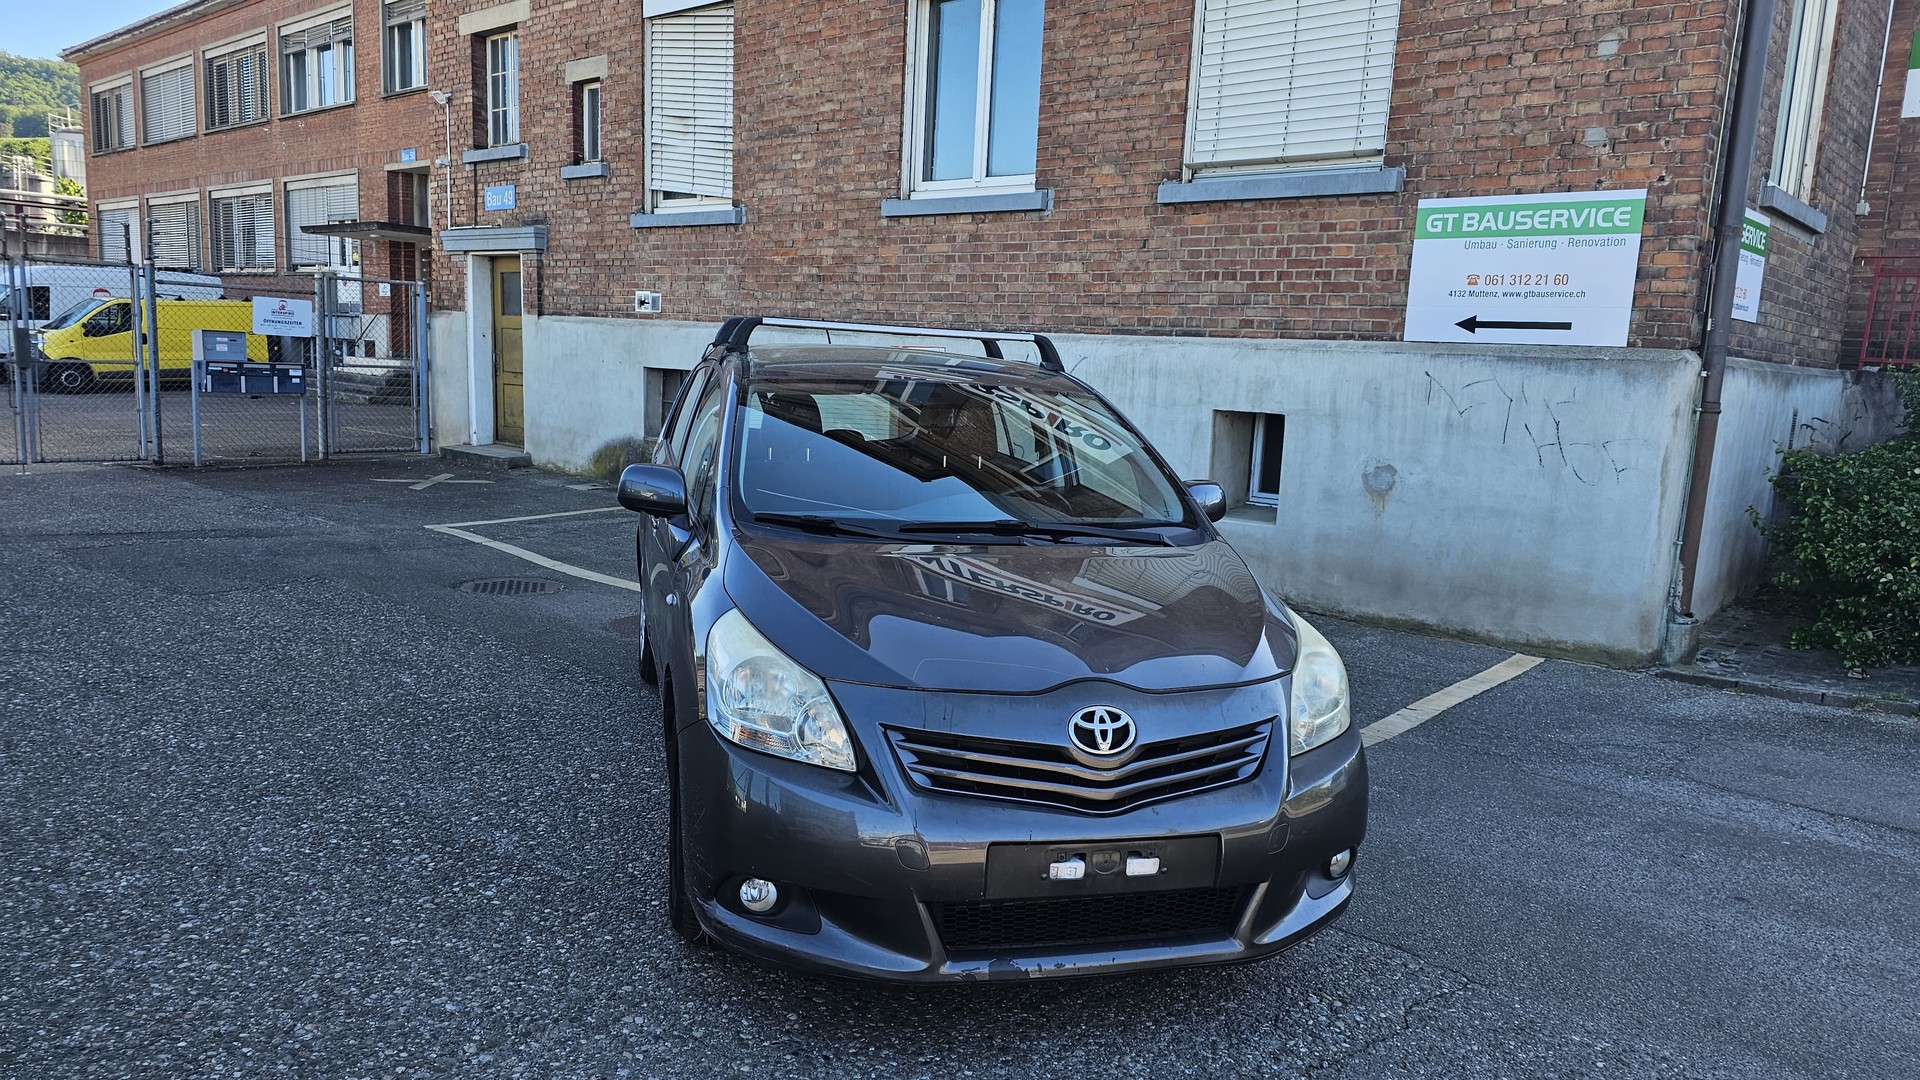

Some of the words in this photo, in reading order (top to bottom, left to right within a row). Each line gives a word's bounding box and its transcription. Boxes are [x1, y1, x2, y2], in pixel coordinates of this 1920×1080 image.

[487, 192, 501, 207] Bau
[503, 189, 513, 205] 49
[1426, 213, 1459, 232] GT
[1462, 206, 1632, 232] BAUSERVICE
[1464, 240, 1498, 250] Umbau
[1506, 238, 1558, 250] Sanierung
[1567, 236, 1627, 248] Renovation
[1484, 274, 1505, 286] 061
[1509, 274, 1531, 286] 312
[1535, 274, 1550, 286] 21
[1553, 273, 1570, 286] 60
[1448, 290, 1467, 298] 4132
[1468, 290, 1501, 299] Muttenz,
[1502, 289, 1586, 299] www.gtbauservice.ch
